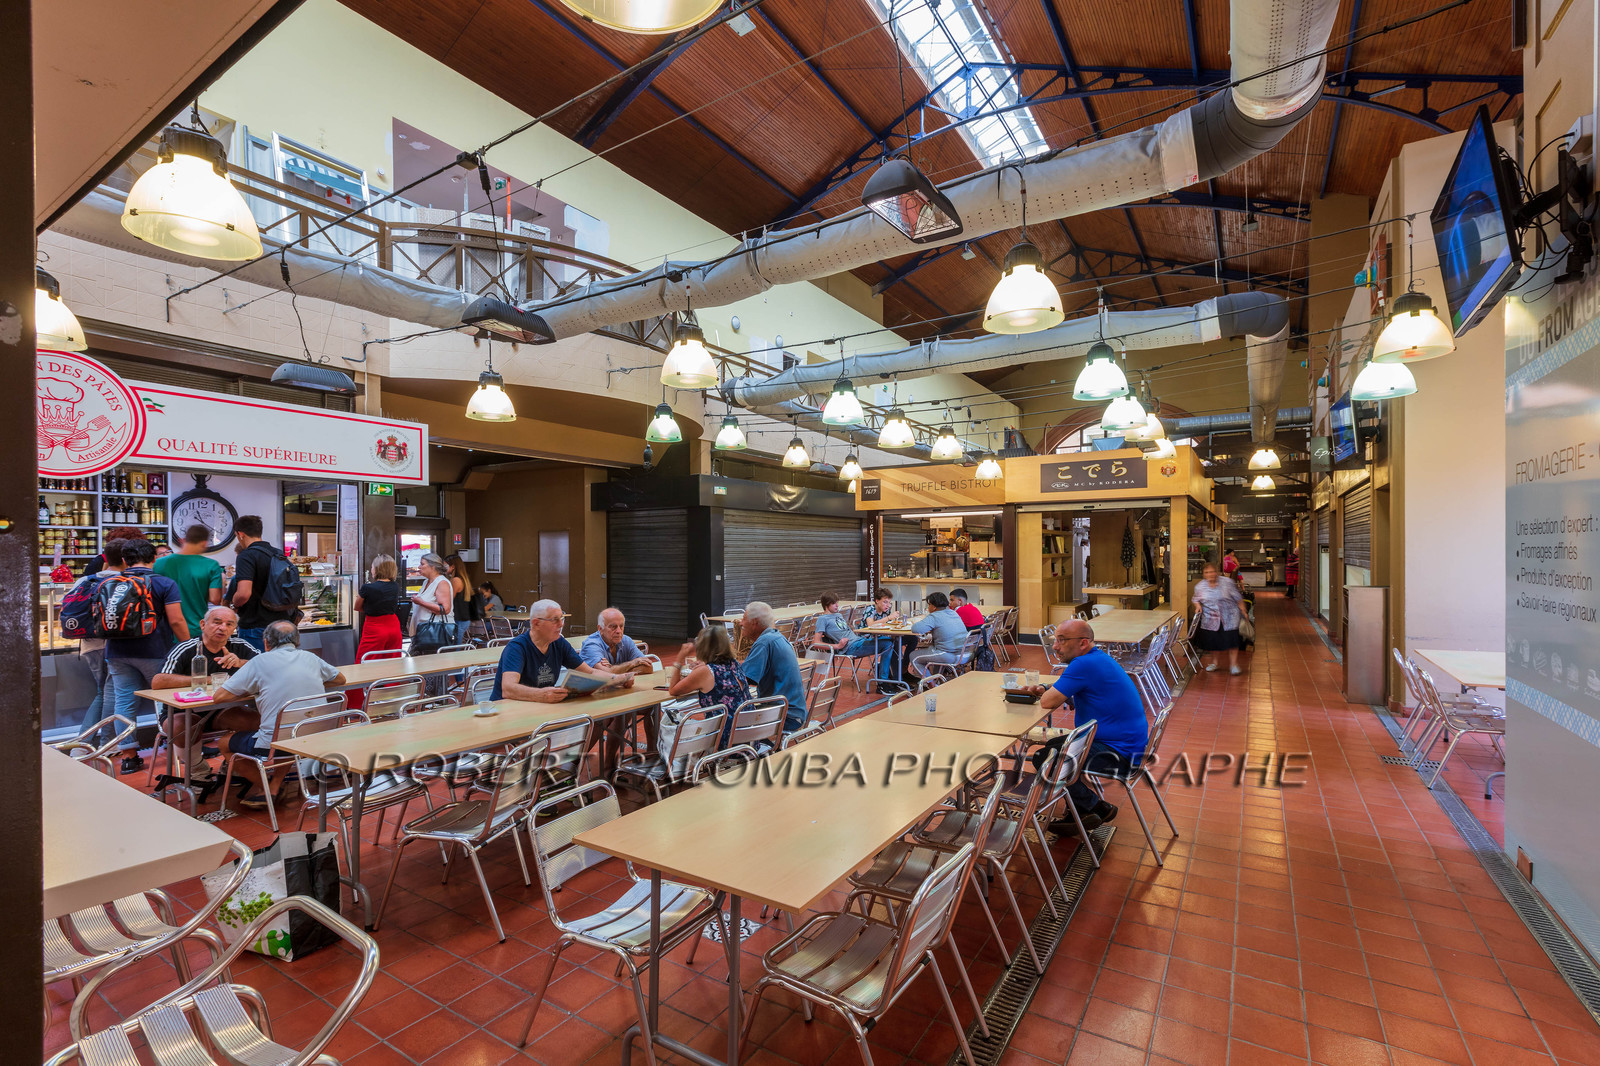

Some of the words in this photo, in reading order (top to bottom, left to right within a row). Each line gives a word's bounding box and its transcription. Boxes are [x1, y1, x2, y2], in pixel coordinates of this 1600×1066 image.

[48, 361, 83, 379] DES
[84, 373, 124, 412] PÂTES
[77, 436, 118, 462] Artisanale
[157, 437, 238, 457] QUALITÉ
[243, 445, 338, 466] SUPÉRIEURE
[1057, 460, 1128, 480] こでら
[1515, 442, 1585, 485] FROMAGERIE
[901, 481, 946, 493] TRUFFLE
[950, 479, 998, 491] BISTROT
[179, 508, 189, 517] 10
[197, 500, 208, 509] 12
[1515, 519, 1529, 536] Une
[1529, 517, 1558, 536] sélection
[1560, 513, 1593, 537] d'expert
[1520, 542, 1553, 563] Fromages
[1553, 541, 1578, 560] affinés
[1520, 566, 1547, 586] Produits
[1547, 569, 1593, 594] d'exception
[1520, 591, 1557, 615] Savoir-faire
[1557, 598, 1597, 623] régionaux
